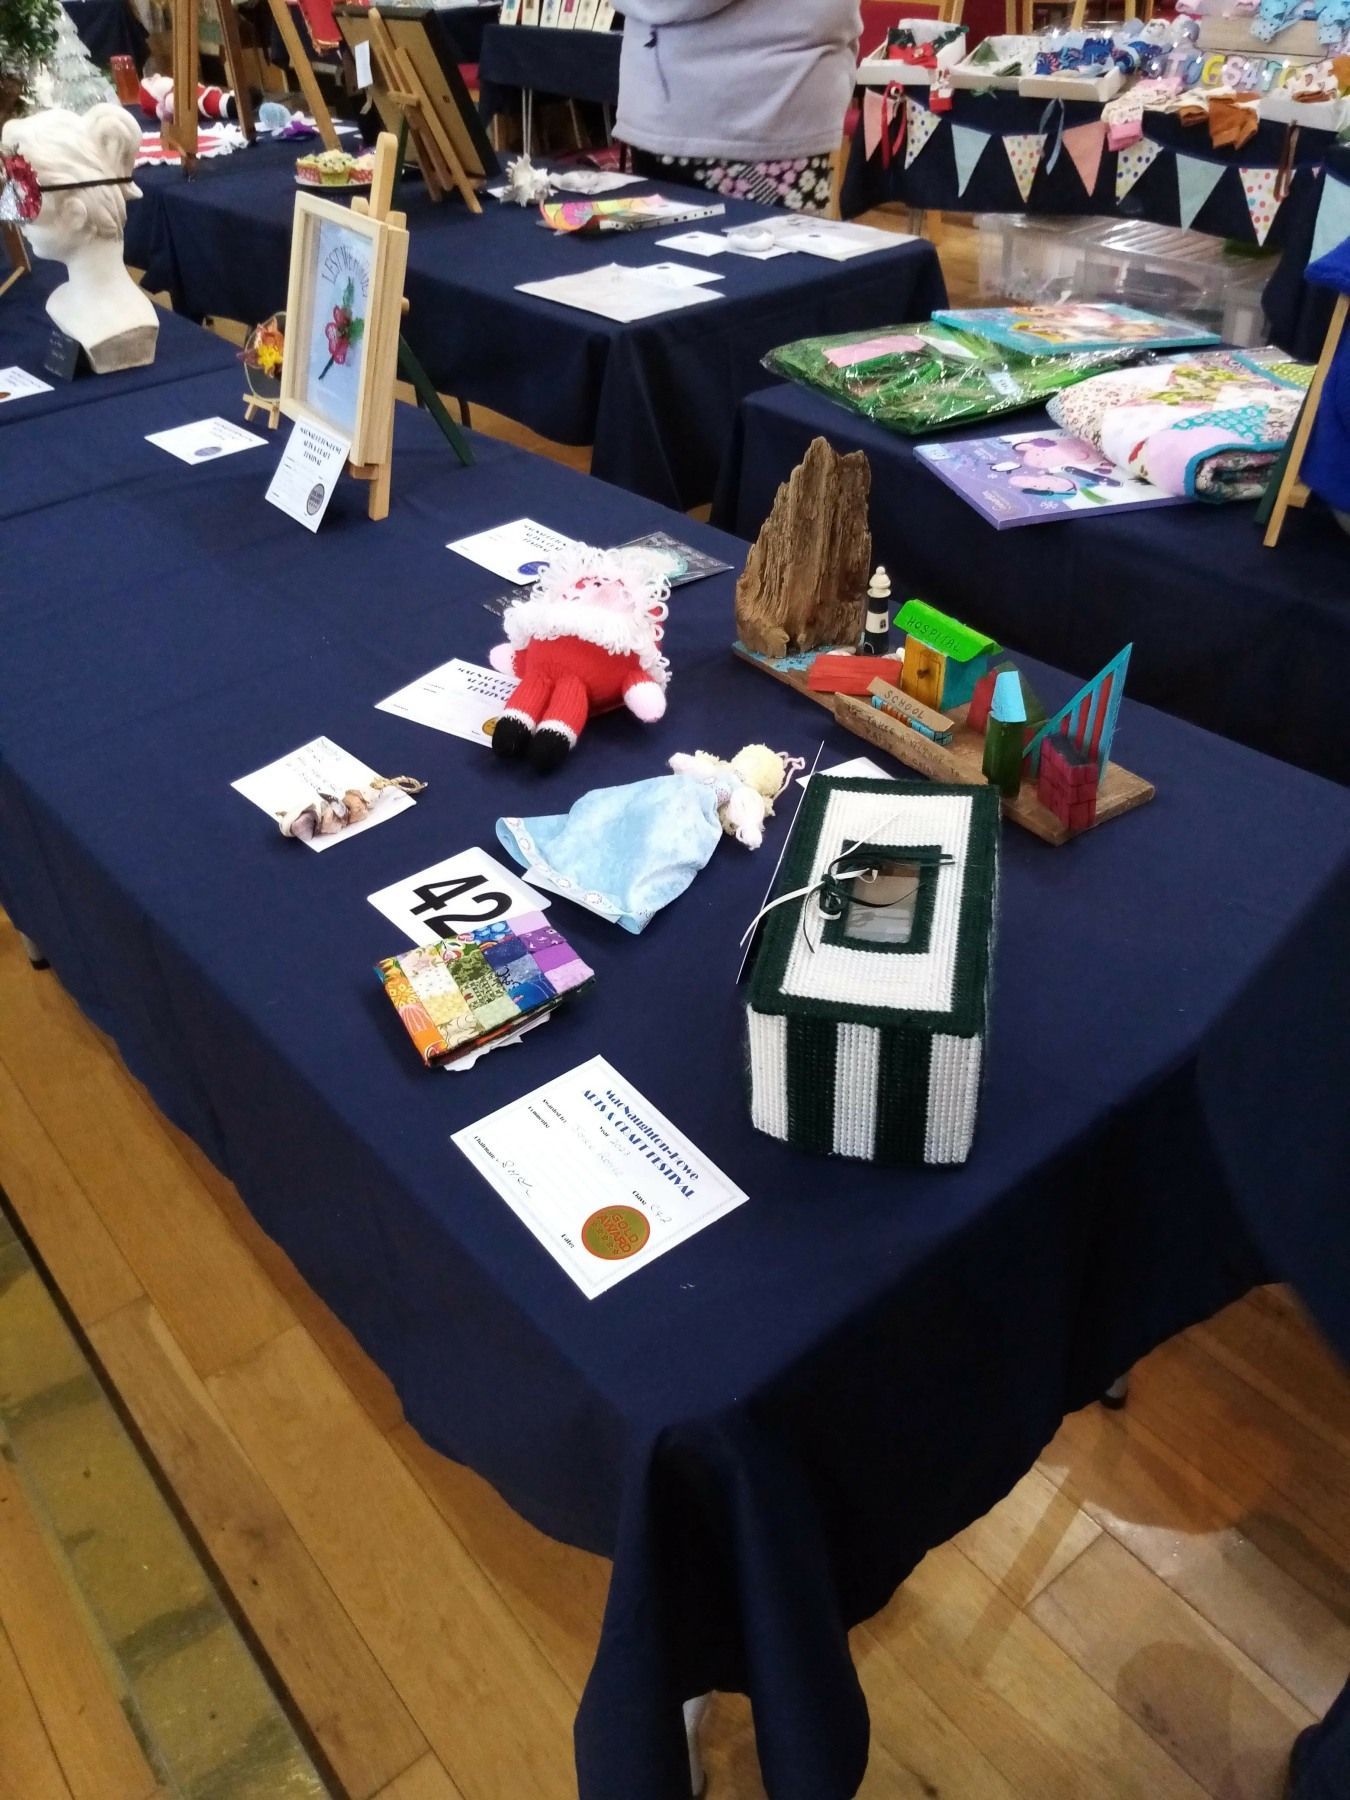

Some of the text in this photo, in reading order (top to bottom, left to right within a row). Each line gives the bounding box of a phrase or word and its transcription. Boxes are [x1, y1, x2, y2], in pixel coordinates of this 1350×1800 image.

[906, 616, 963, 652] HOSPITAL
[884, 690, 924, 720] SCHOOL
[409, 874, 512, 940] 42
[583, 1089, 608, 1113] ARTS
[614, 1119, 649, 1152] CRAFT
[645, 1150, 695, 1199] FESTIVAL
[597, 1215, 632, 1253] AWARD
[611, 1213, 639, 1244] GOLD
